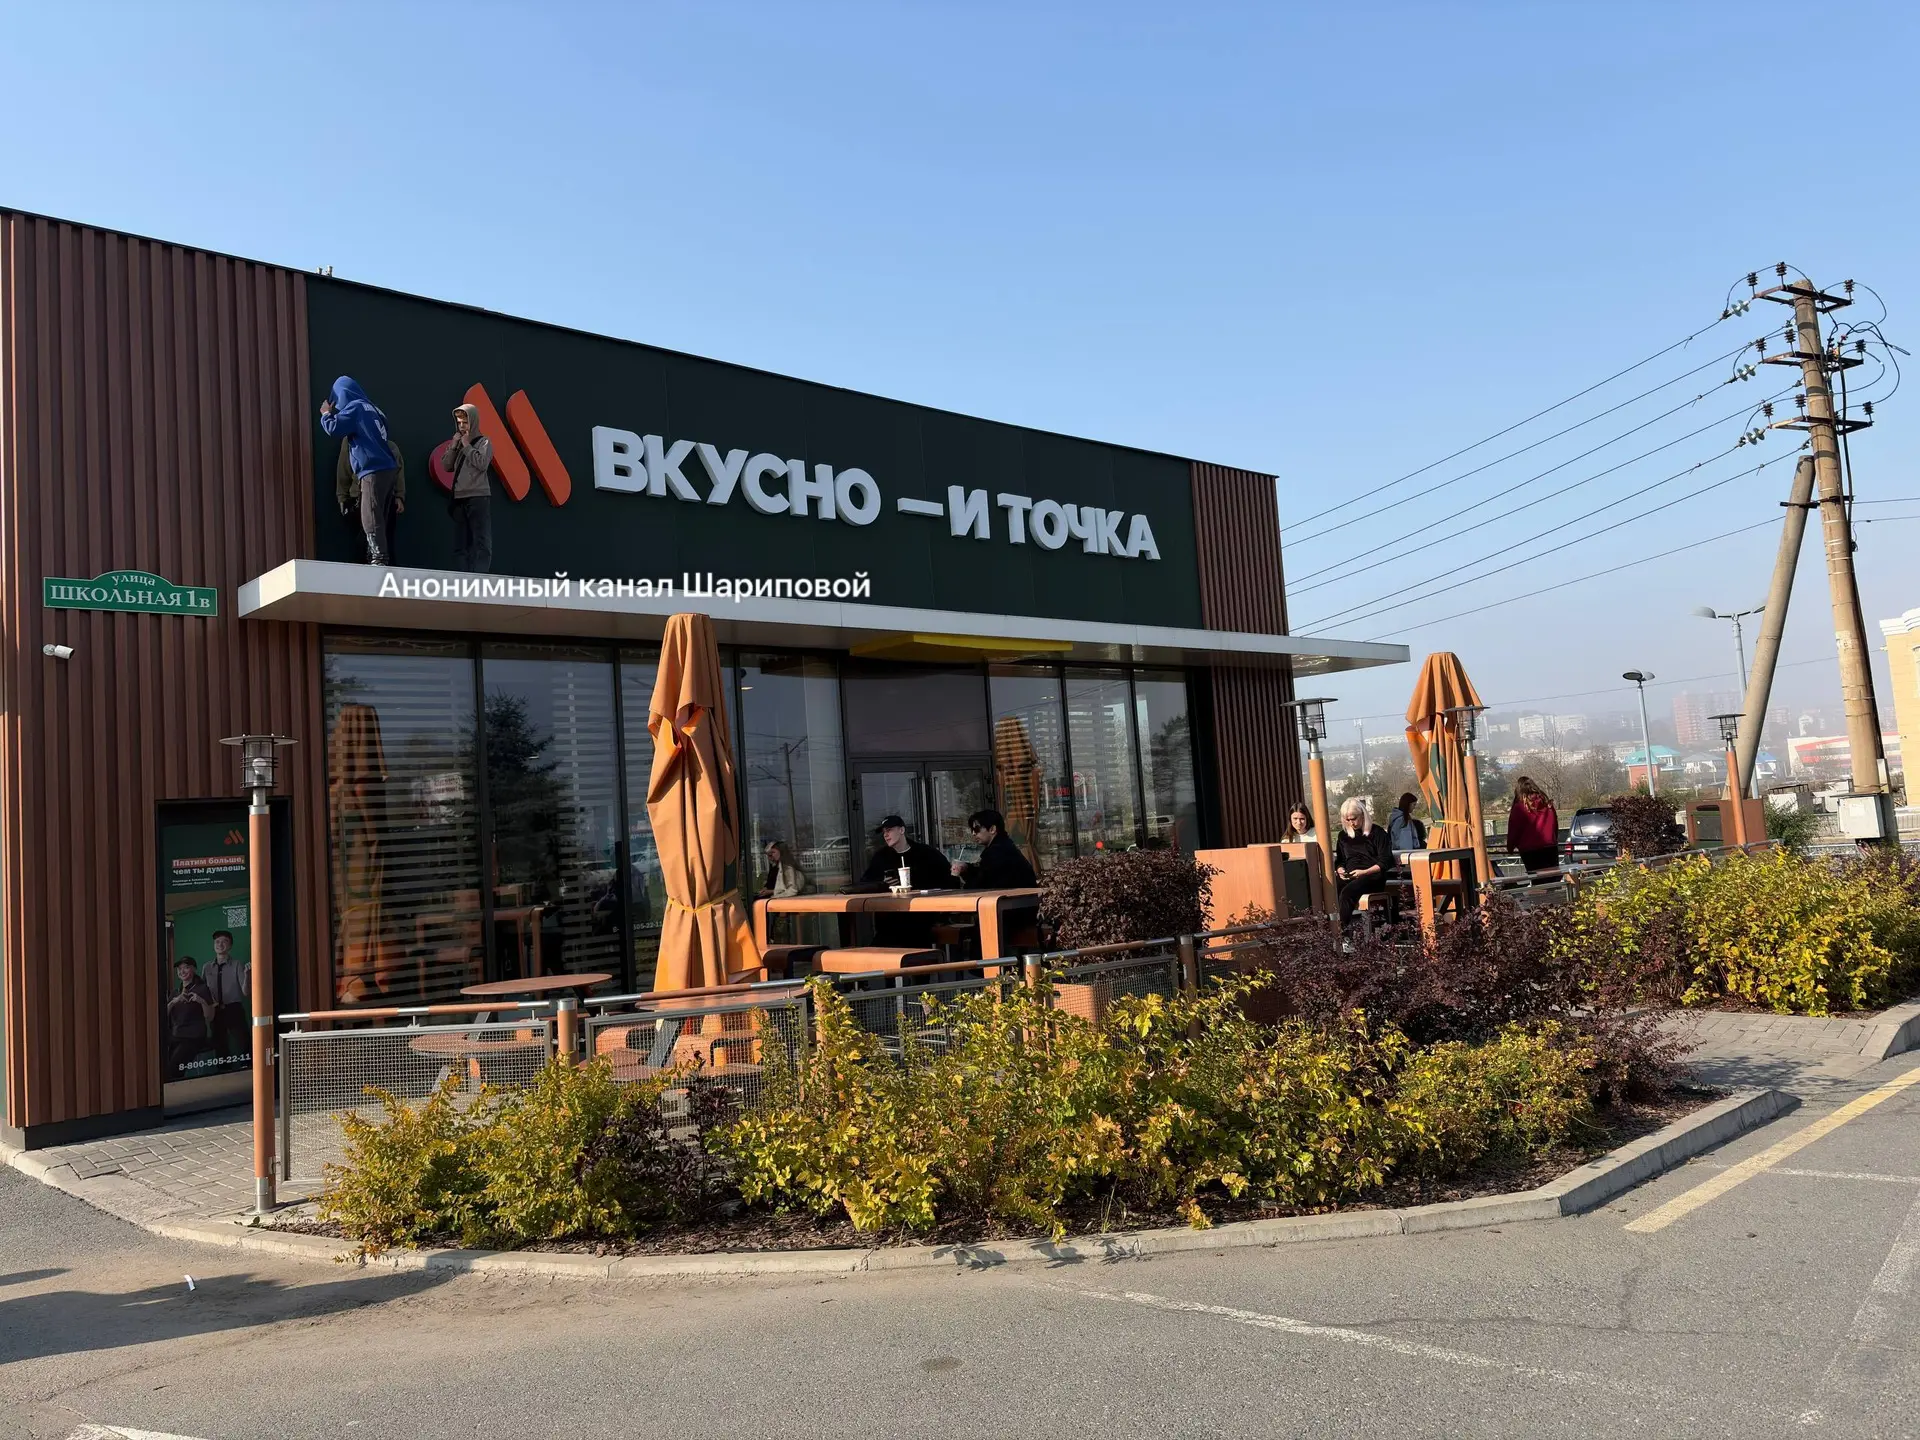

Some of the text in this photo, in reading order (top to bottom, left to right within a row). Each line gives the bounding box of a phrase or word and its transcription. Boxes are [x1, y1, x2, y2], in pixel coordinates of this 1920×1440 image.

[592, 425, 882, 527] ВКУСНО
[947, 485, 991, 541] И
[997, 491, 1161, 560] ТОЧКА
[111, 574, 156, 586] улица
[50, 585, 182, 607] ШКОЛЬНАЯ
[172, 859, 207, 867] Платим
[192, 867, 205, 875] ты
[206, 865, 246, 874] думаешь
[178, 1053, 251, 1071] 8-800-505-22-11
